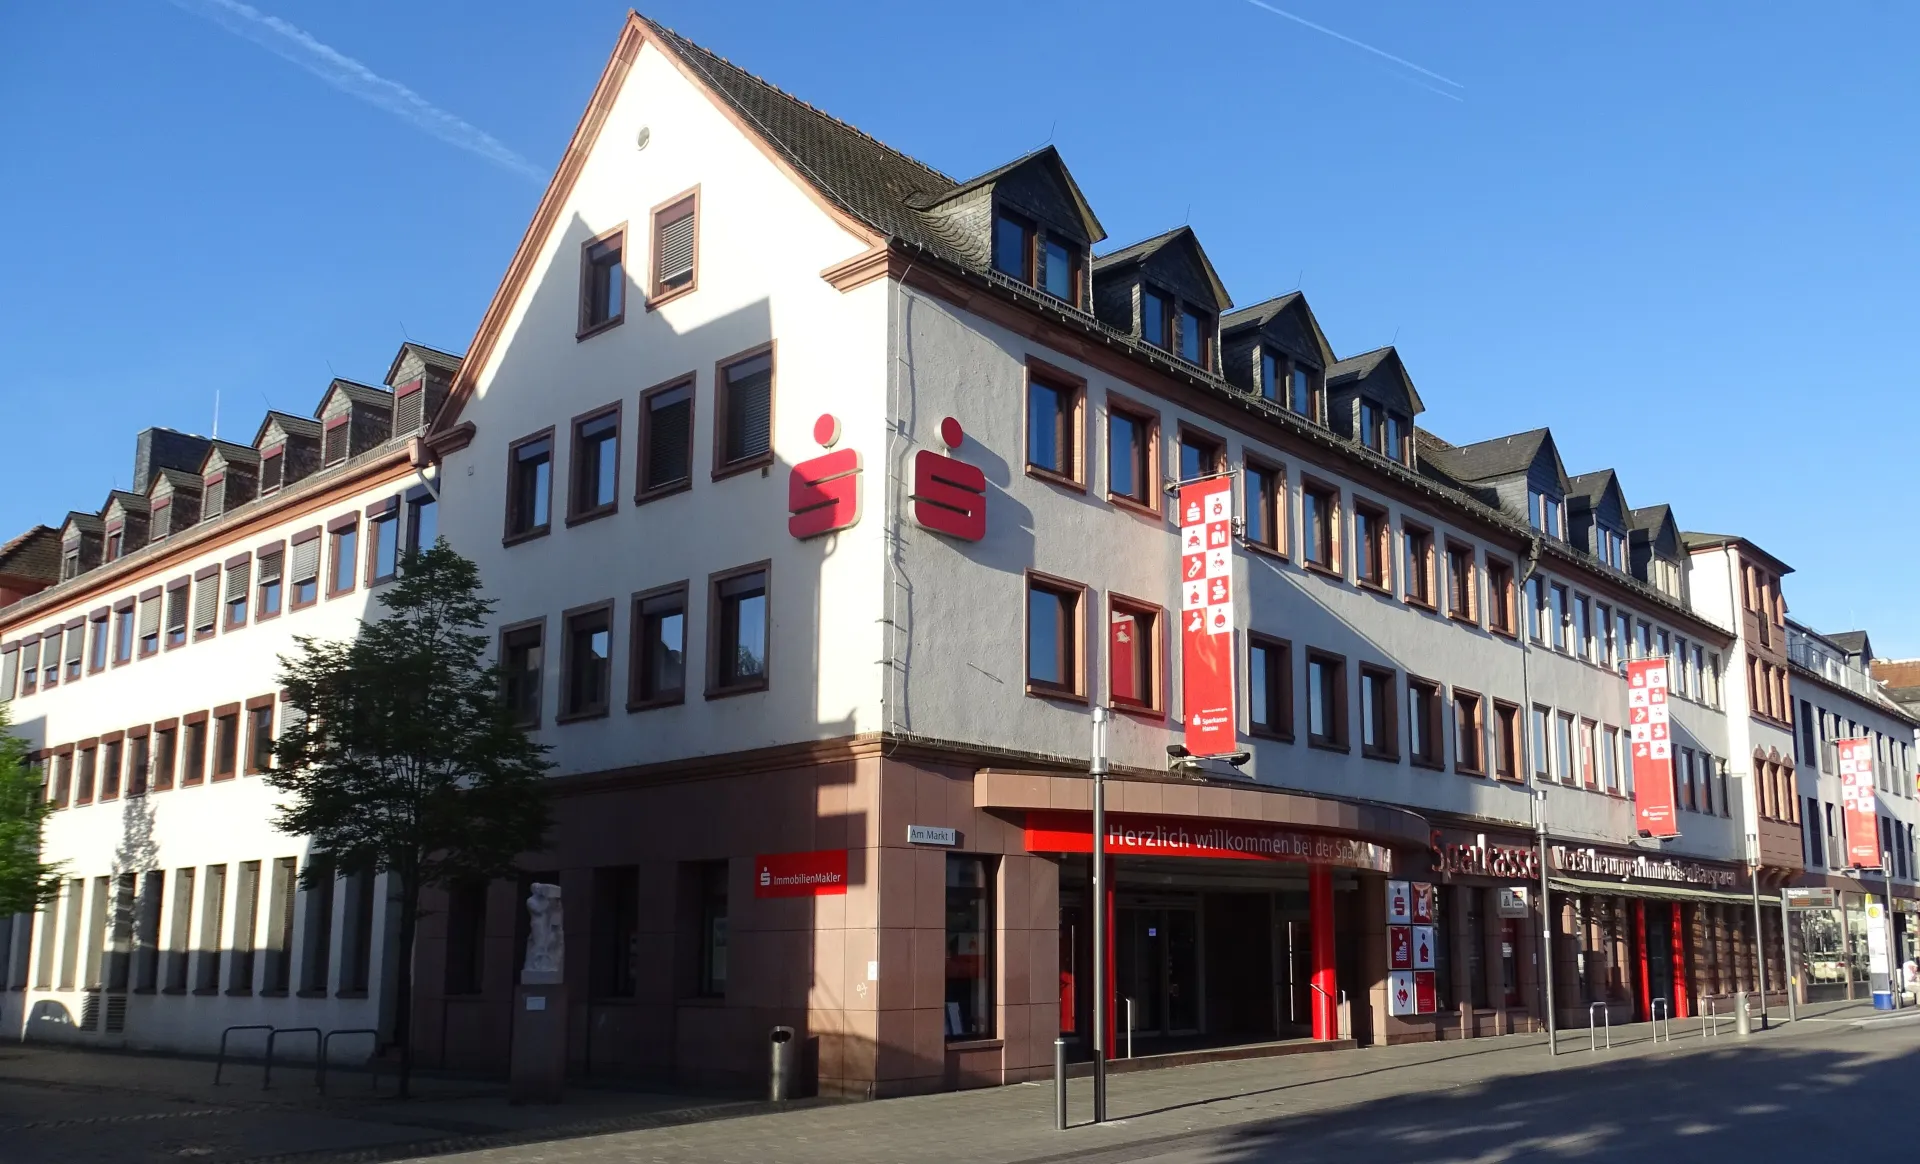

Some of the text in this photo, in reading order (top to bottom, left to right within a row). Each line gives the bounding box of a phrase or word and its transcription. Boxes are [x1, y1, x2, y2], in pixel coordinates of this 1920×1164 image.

[911, 829, 924, 839] Am
[926, 830, 948, 841] Markt
[1109, 824, 1190, 849] Herzlich
[1195, 828, 1290, 855] willkommen
[1293, 835, 1313, 857] bei
[1315, 840, 1334, 858] der
[1429, 829, 1540, 880] Sparkasse
[773, 871, 841, 885] ImmobilienMakler
